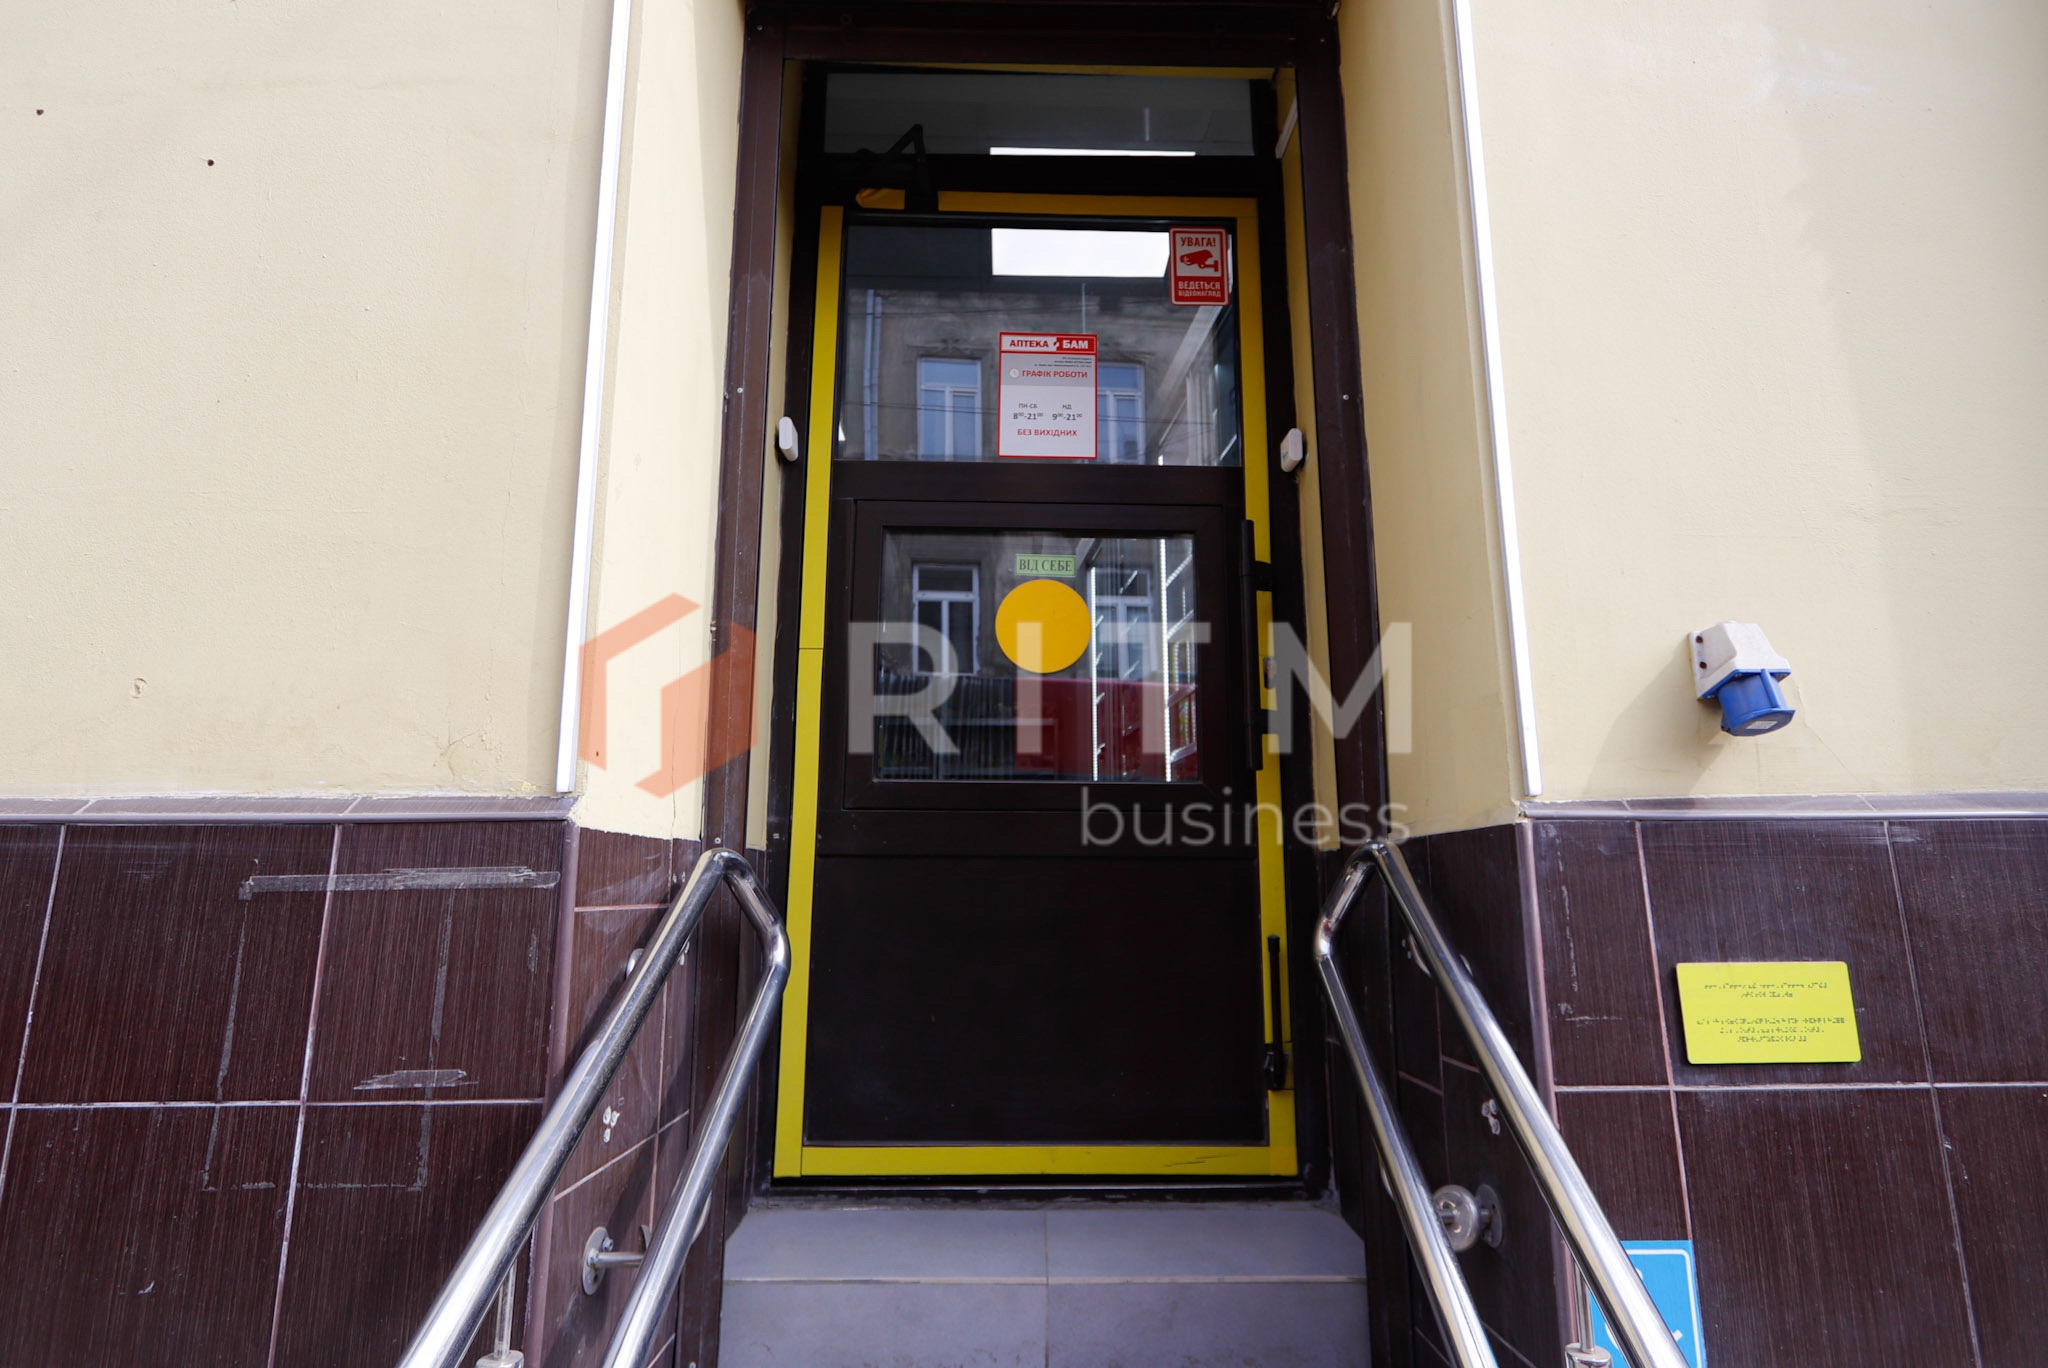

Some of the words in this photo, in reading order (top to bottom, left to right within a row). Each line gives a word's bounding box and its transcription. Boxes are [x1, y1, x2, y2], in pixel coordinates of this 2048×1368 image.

[1180, 236, 1217, 247] УВАГА!
[1178, 281, 1221, 290] ВЕДЕТЬСЯ
[1009, 339, 1049, 348] АПТЕКА
[1062, 339, 1089, 349] БАМ
[1022, 370, 1052, 378] ГРАФІК
[1053, 370, 1088, 379] РОБОТИ
[1034, 429, 1078, 437] ВИХІДНИХ
[1019, 559, 1039, 572] ВІД
[1041, 559, 1072, 572] СЕБЕ
